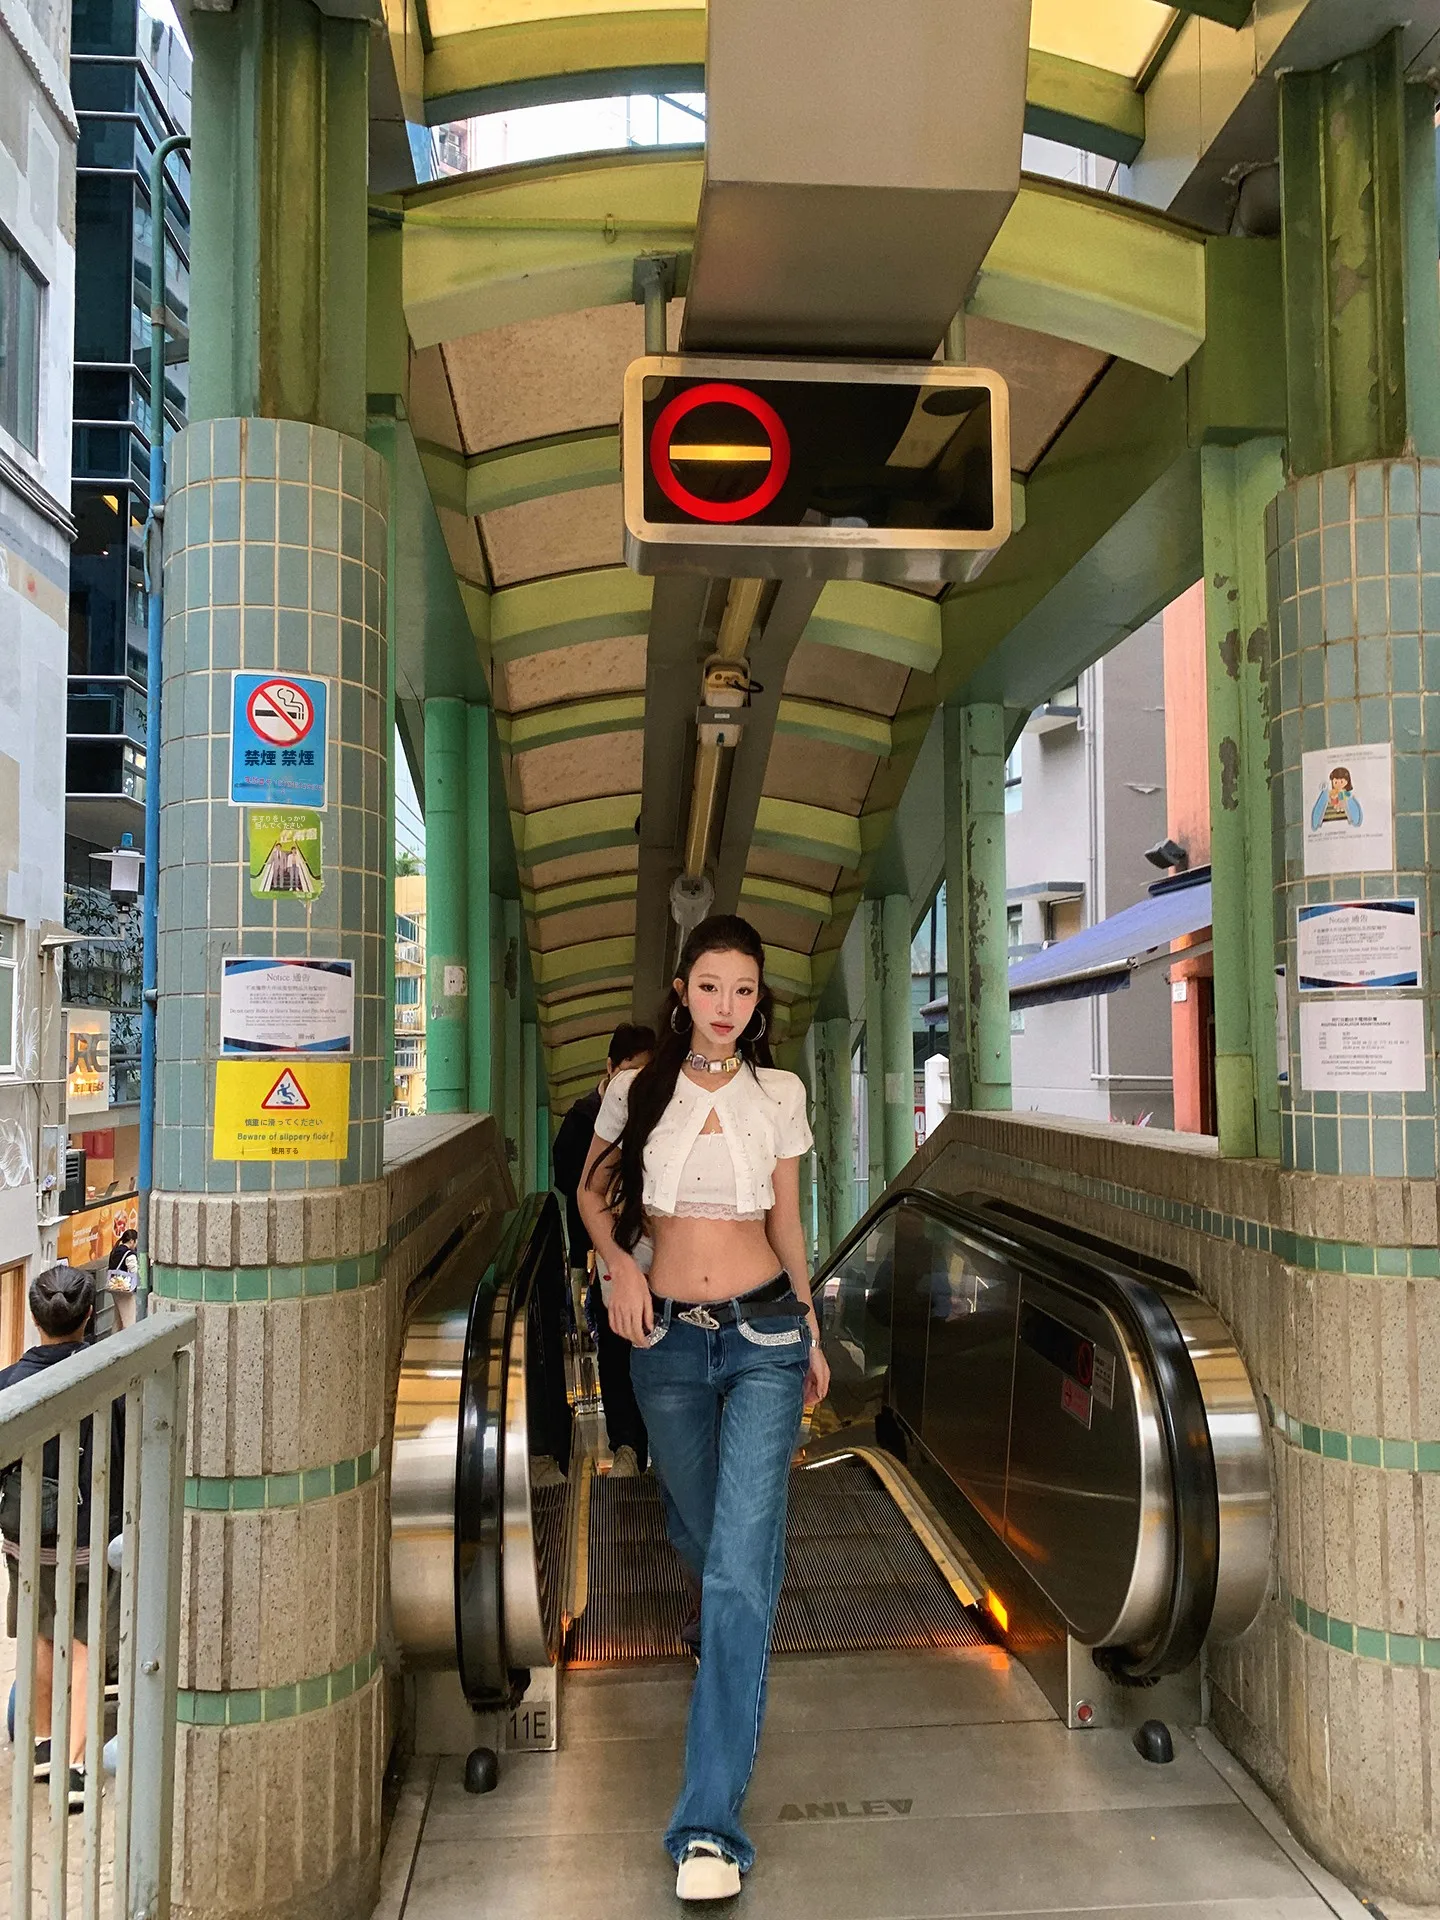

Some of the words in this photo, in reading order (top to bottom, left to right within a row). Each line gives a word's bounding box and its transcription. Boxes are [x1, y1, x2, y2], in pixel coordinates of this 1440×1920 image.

[244, 749, 276, 766] 禁煙
[281, 749, 315, 766] 禁煙
[266, 973, 290, 982] Notice
[292, 973, 311, 982] 通告
[237, 1132, 266, 1141] Beware
[269, 1132, 278, 1141] of
[279, 1132, 311, 1142] slippery
[510, 1711, 547, 1739] 11E
[777, 1798, 913, 1821] ANLEV
